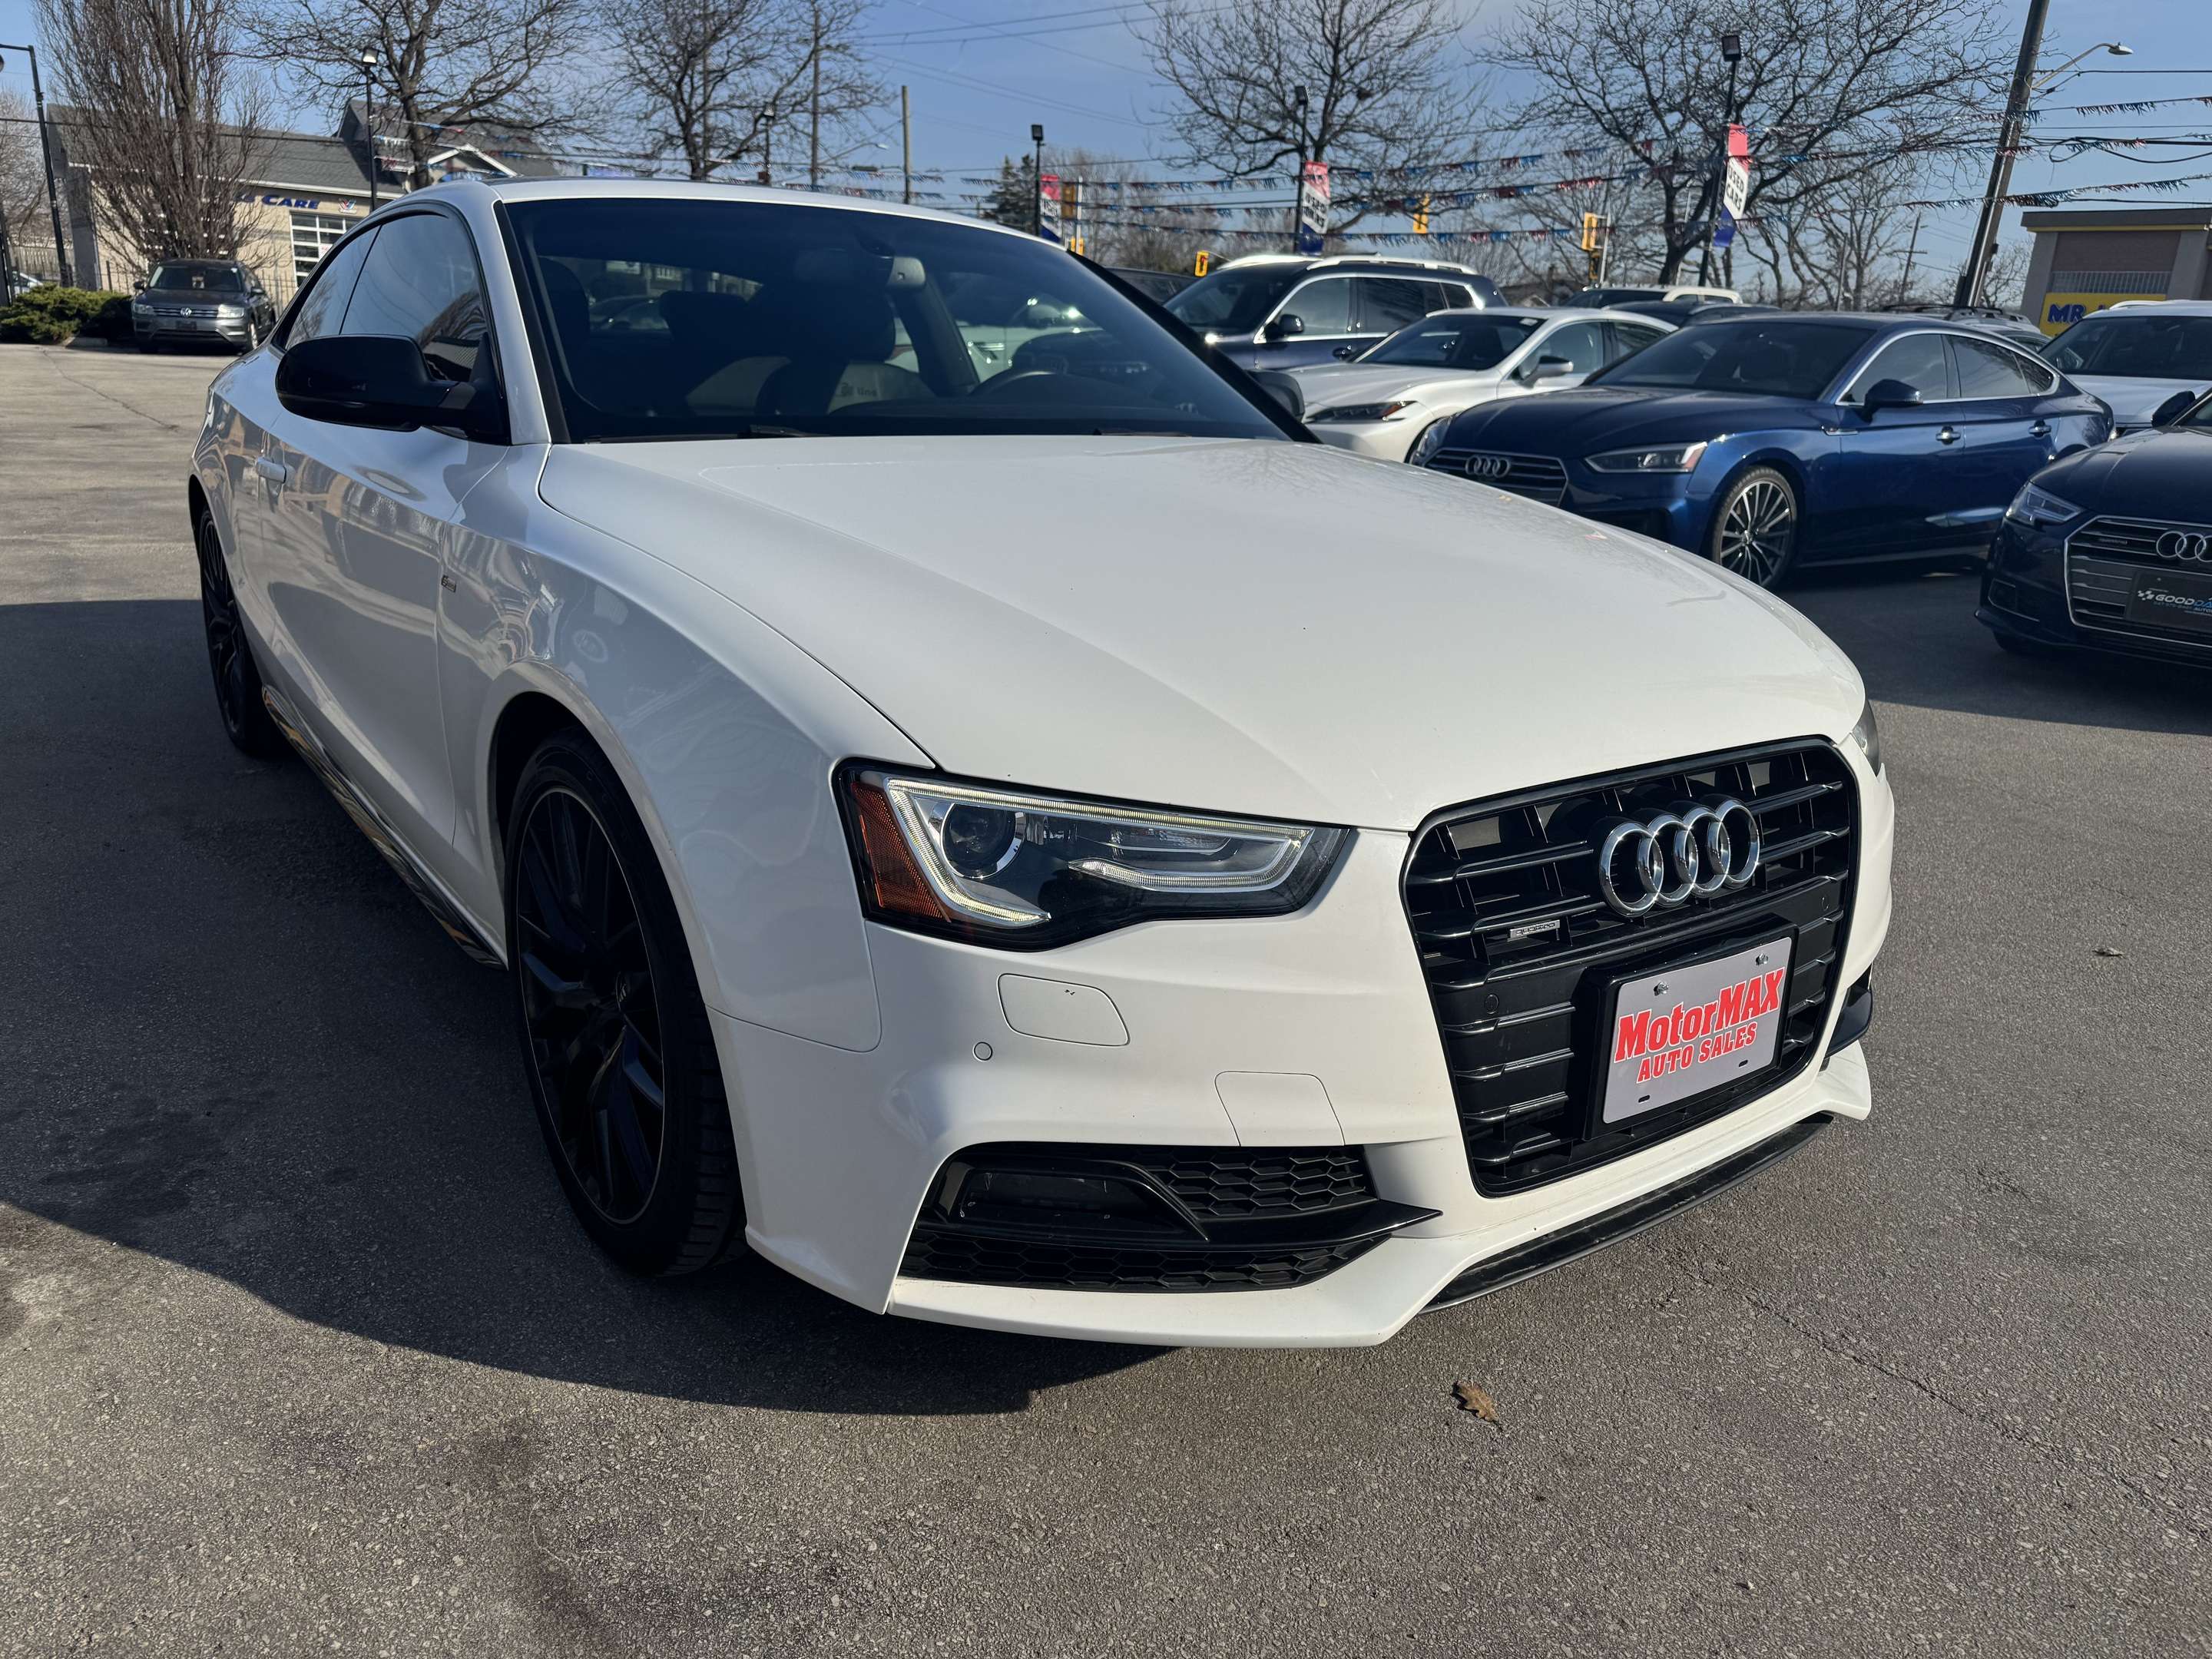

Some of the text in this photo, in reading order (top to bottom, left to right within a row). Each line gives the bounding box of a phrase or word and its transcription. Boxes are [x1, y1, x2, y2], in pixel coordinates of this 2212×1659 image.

[1728, 165, 1744, 192] USED
[1727, 184, 1742, 210] CARS
[2048, 304, 2086, 323] MR
[1614, 966, 1786, 1064] MotorMAX
[1636, 1021, 1758, 1084] AUTO SALES
